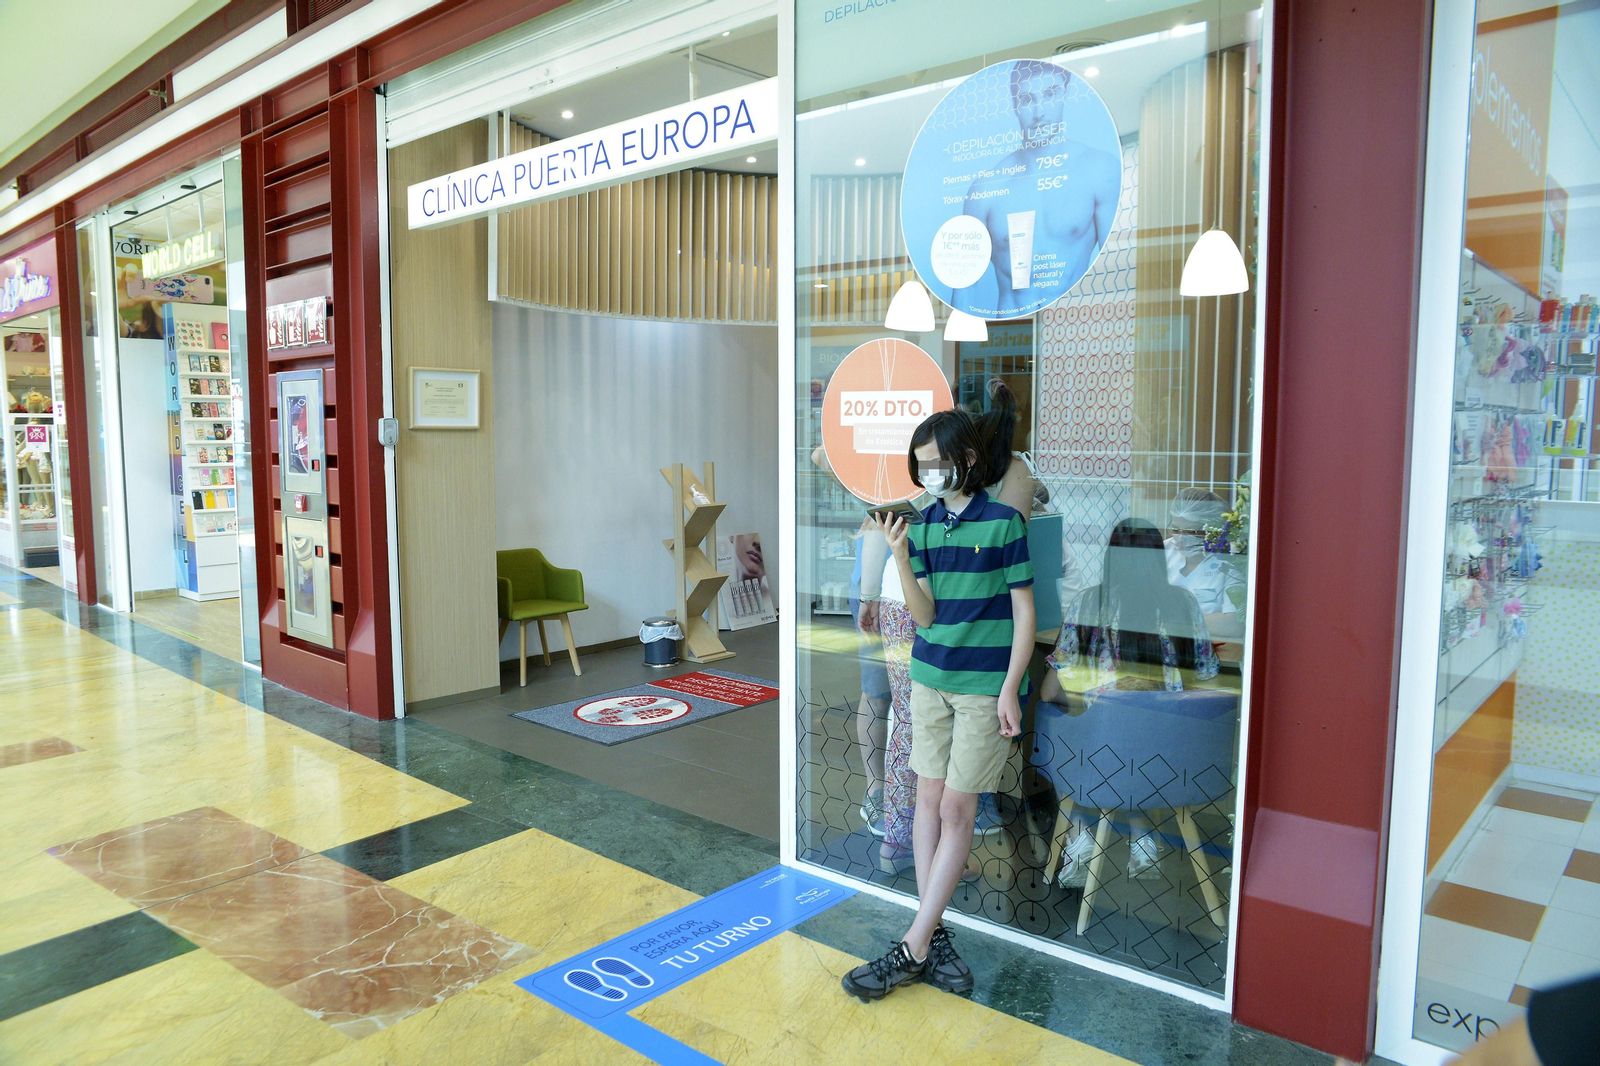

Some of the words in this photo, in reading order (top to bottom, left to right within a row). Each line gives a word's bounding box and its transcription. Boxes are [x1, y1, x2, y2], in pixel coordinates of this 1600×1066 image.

[824, 0, 897, 23] DEPILAC
[953, 129, 1025, 154] DEPILACIÓN
[1027, 121, 1068, 140] LÁSER
[953, 150, 992, 162] INDOLORA
[993, 148, 1004, 156] DE
[1005, 144, 1025, 154] ALTA
[1026, 135, 1067, 150] POTENCIA
[422, 170, 506, 217] CLÍNICA
[514, 139, 612, 194] PUERTA
[622, 99, 756, 166] EUROPA
[943, 174, 971, 185] Piernas
[978, 170, 995, 179] Pies
[1002, 164, 1027, 176] Ingles
[943, 195, 963, 205] Tórax
[970, 188, 1010, 201] Abdomen
[941, 232, 948, 240] Y
[948, 233, 963, 241] por
[964, 231, 982, 240] sólo
[141, 243, 181, 279] WORLD
[183, 231, 216, 265] CELL
[961, 242, 980, 251] más
[1033, 253, 1057, 261] Crema
[1033, 263, 1049, 272] post
[1049, 260, 1067, 269] láser
[1033, 270, 1058, 279] natural
[1059, 270, 1064, 278] y
[1033, 279, 1059, 288] vegana
[844, 400, 878, 417] 20%
[884, 399, 927, 417] DTO.
[868, 427, 913, 436] tratamientos
[875, 437, 905, 446] Estética.
[630, 937, 660, 953] POR
[658, 920, 703, 940] FAVOR,
[644, 935, 694, 959] ESPERA
[692, 919, 724, 938] AQUÍ
[660, 950, 700, 969] TU
[692, 916, 772, 953] TURNO
